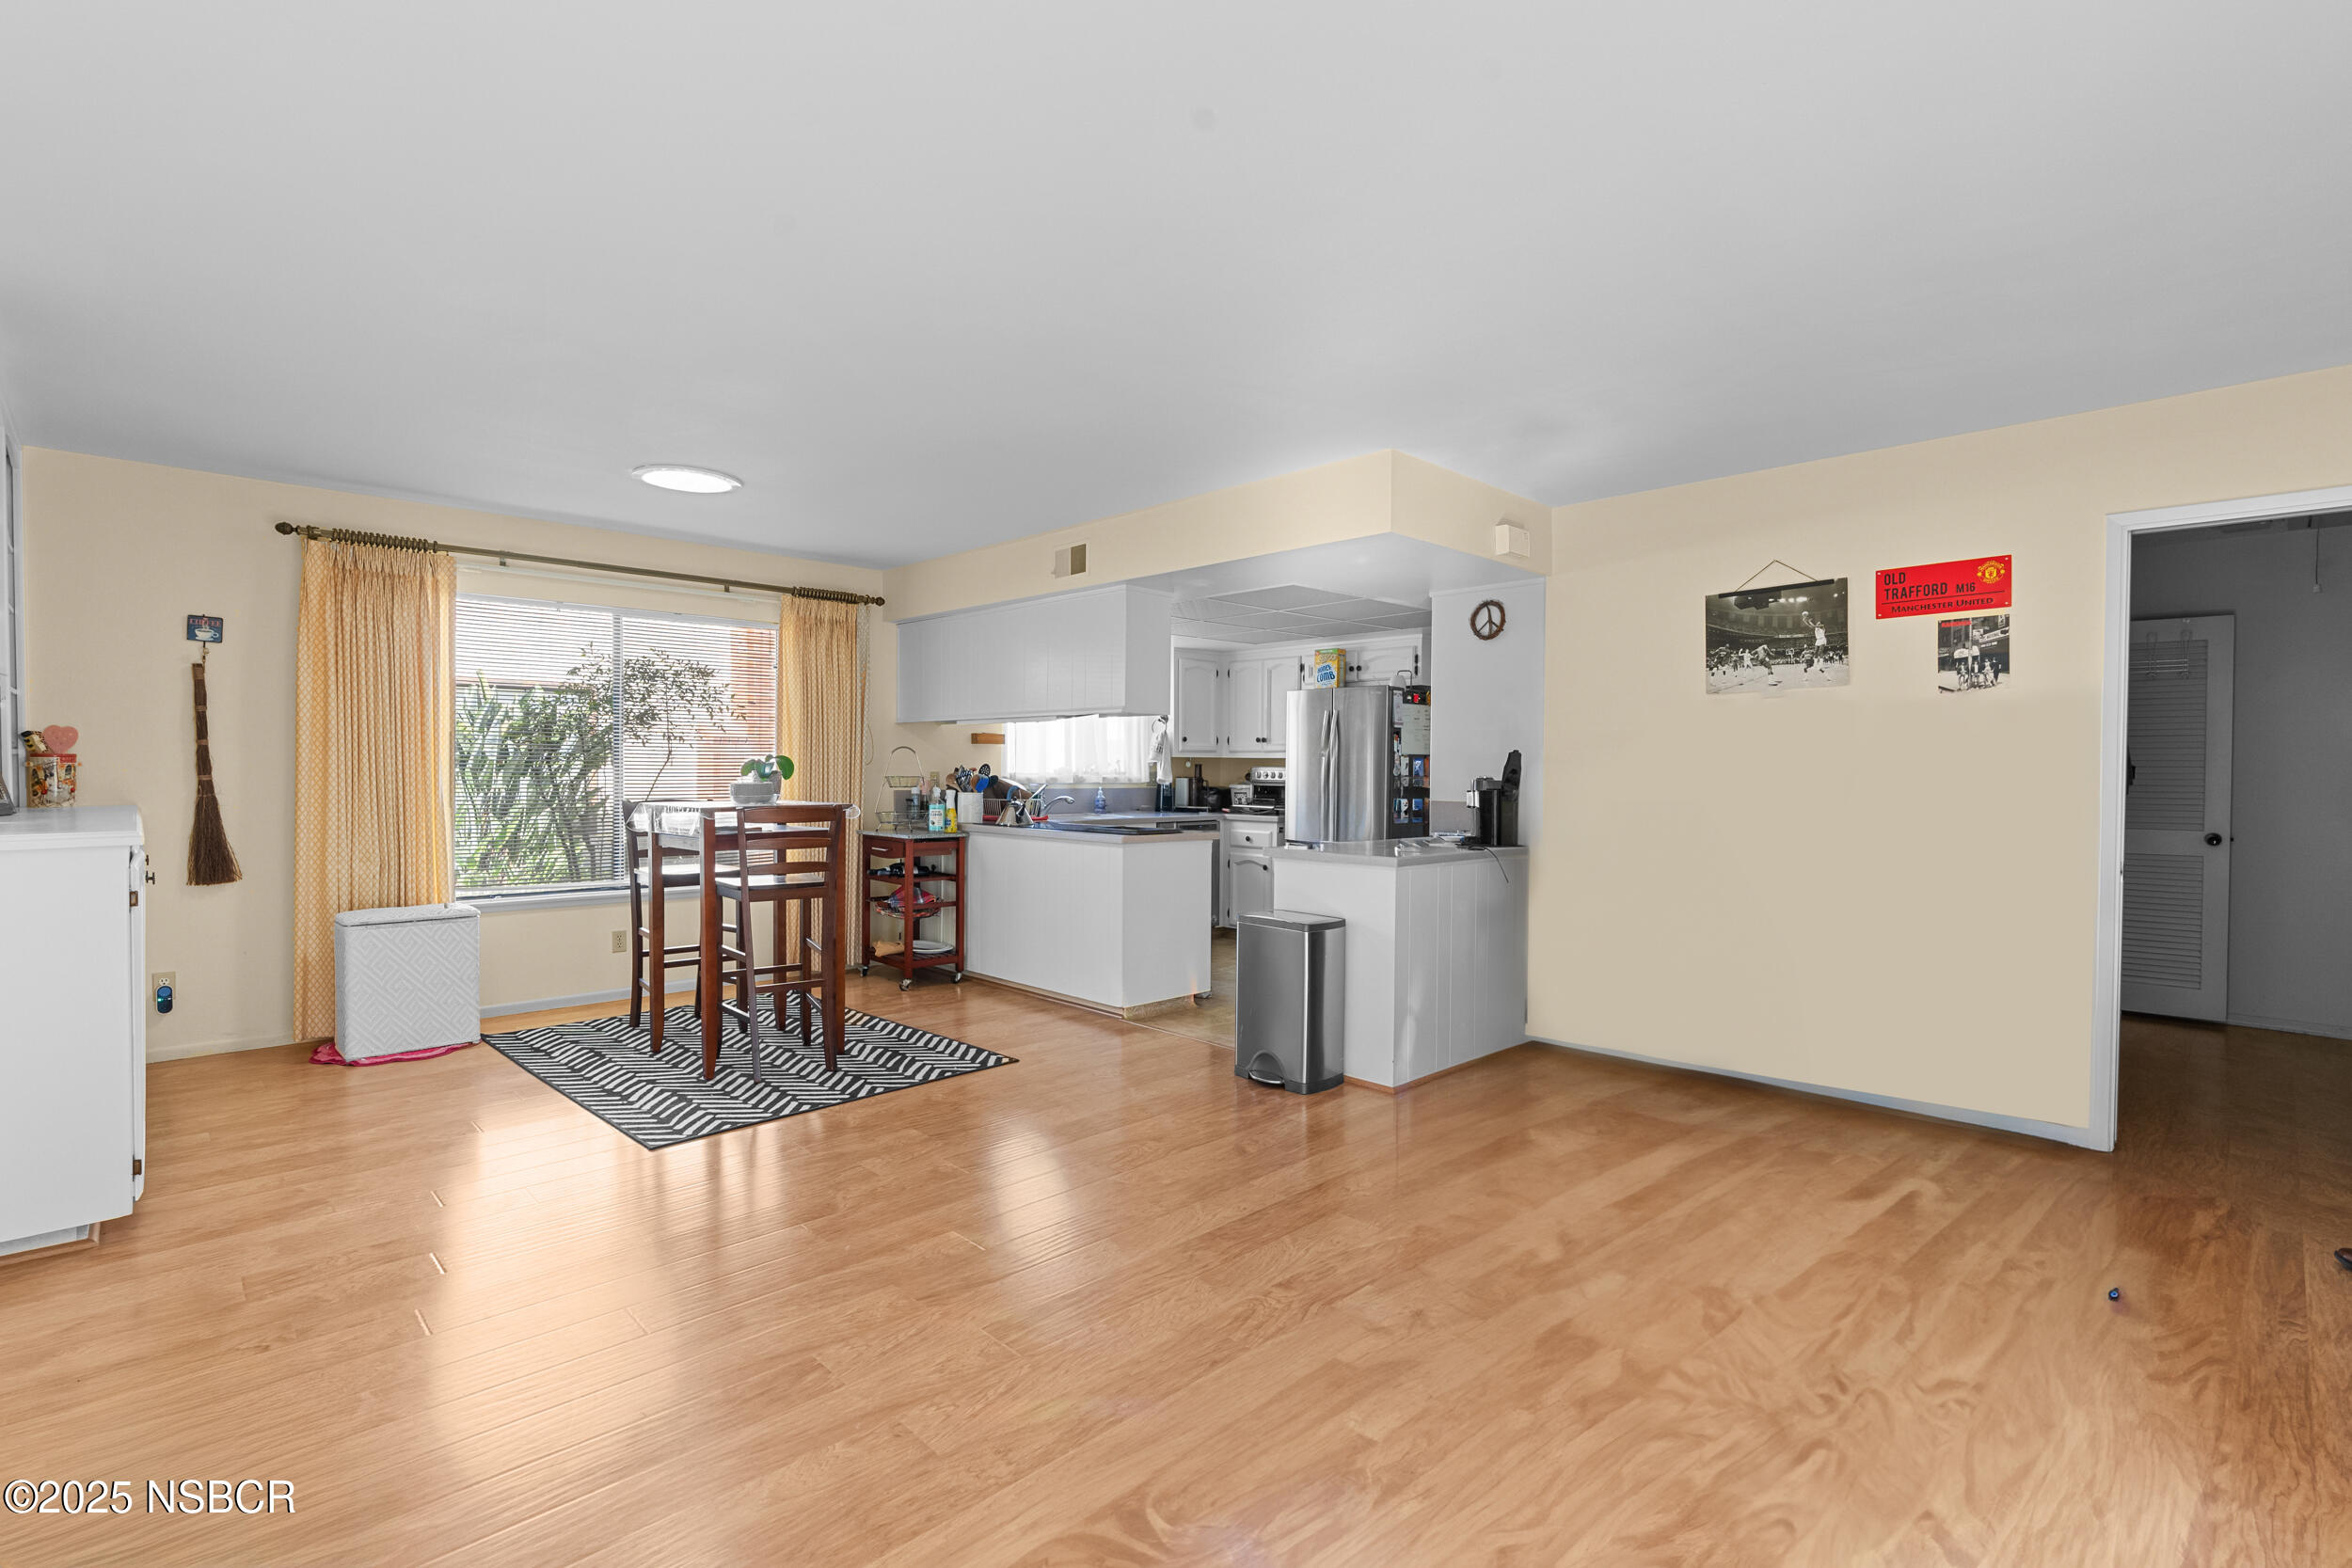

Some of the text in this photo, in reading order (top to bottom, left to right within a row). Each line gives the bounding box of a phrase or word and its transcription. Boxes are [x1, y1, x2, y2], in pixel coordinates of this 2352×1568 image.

[1883, 572, 1906, 586] OLD
[1883, 582, 1976, 601] TRAFFORD M16
[1891, 597, 1994, 614] MANCHESTER UNITED
